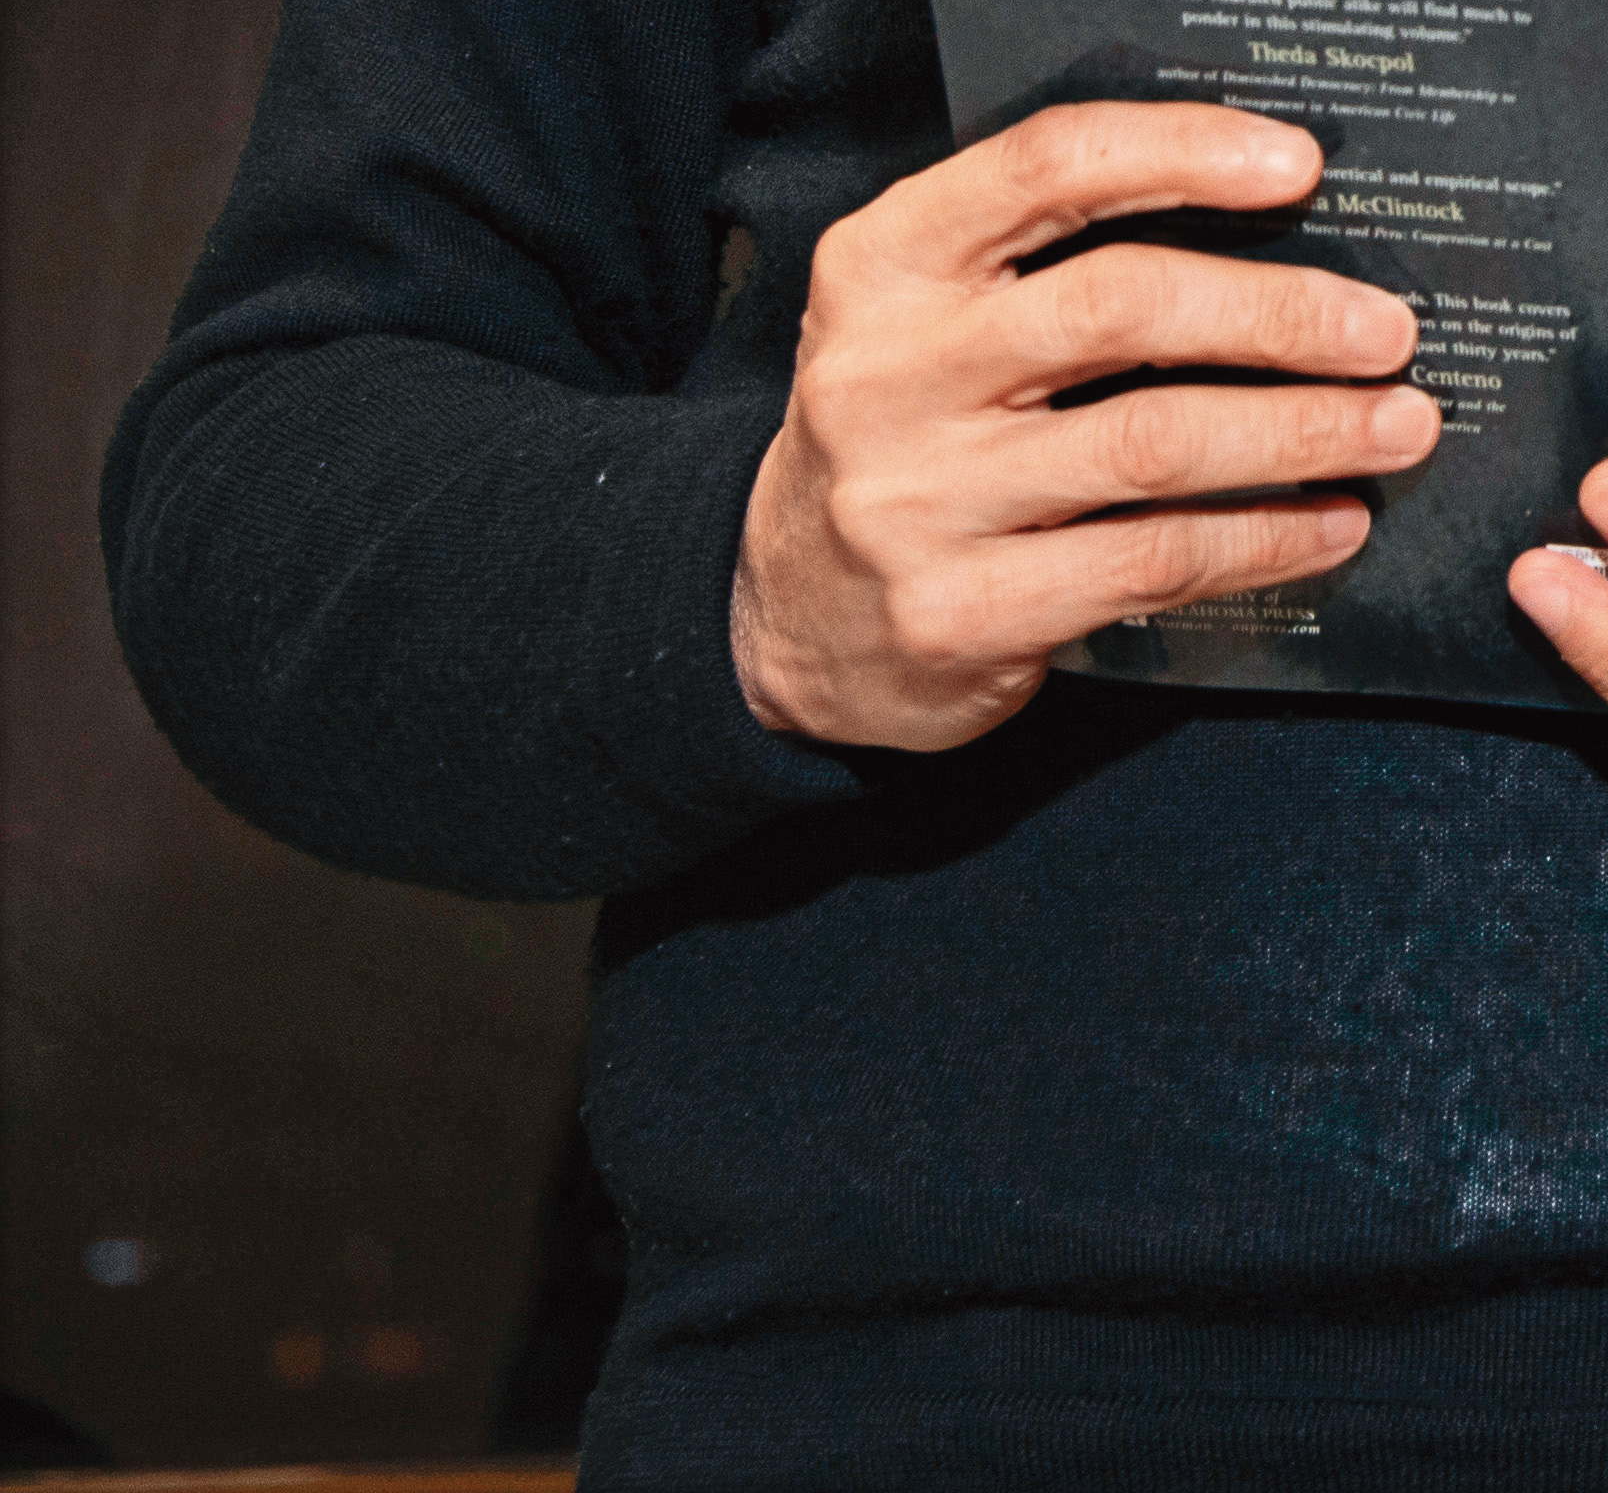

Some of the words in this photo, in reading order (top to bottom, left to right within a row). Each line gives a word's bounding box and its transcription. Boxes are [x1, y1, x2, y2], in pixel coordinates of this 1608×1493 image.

[1248, 41, 1318, 66] Theda
[1325, 46, 1416, 75] Skocpol
[1338, 193, 1464, 222] McClintock
[1436, 293, 1468, 311] This
[1411, 365, 1501, 390] Centeno
